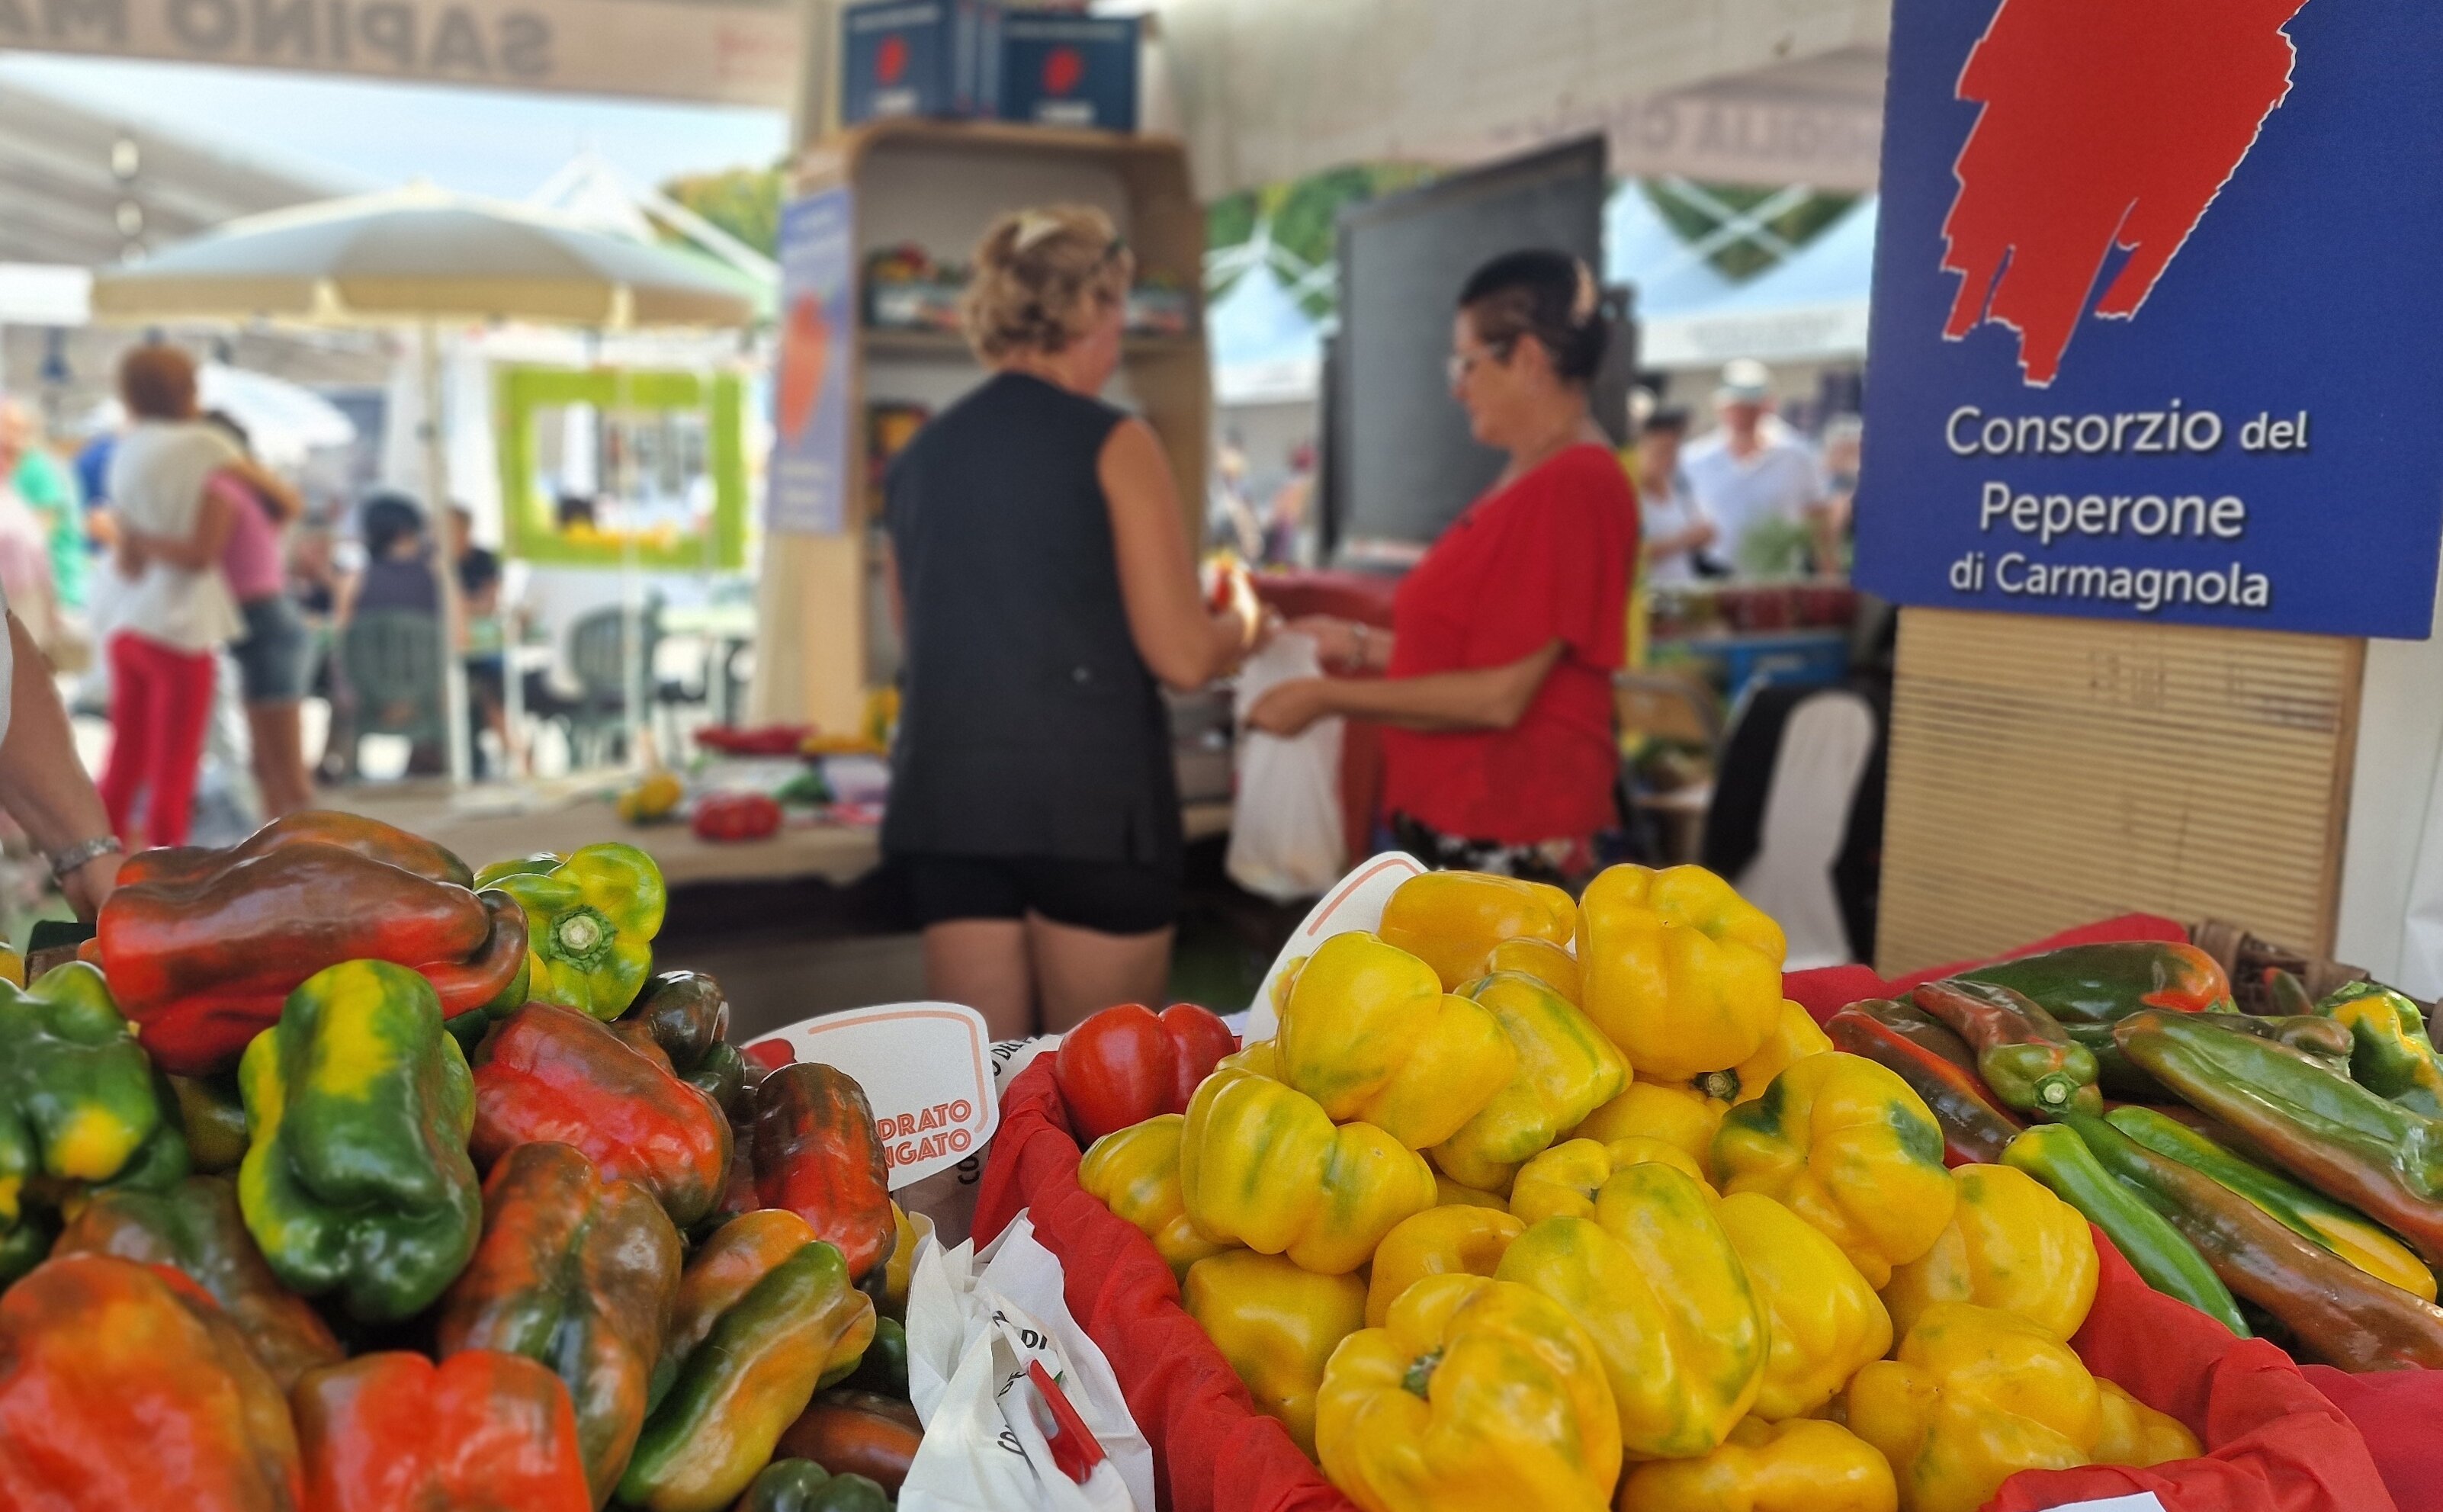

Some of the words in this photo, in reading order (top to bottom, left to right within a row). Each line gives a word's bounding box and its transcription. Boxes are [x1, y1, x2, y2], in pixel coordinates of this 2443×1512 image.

[1945, 398, 2222, 454] Consorzio
[2239, 410, 2307, 449] del
[1979, 482, 2245, 544] Peperone
[1950, 551, 1984, 590] di
[1995, 552, 2269, 611] Carmagnola
[877, 1099, 971, 1141] DRATO
[884, 1128, 972, 1168] NGATO
